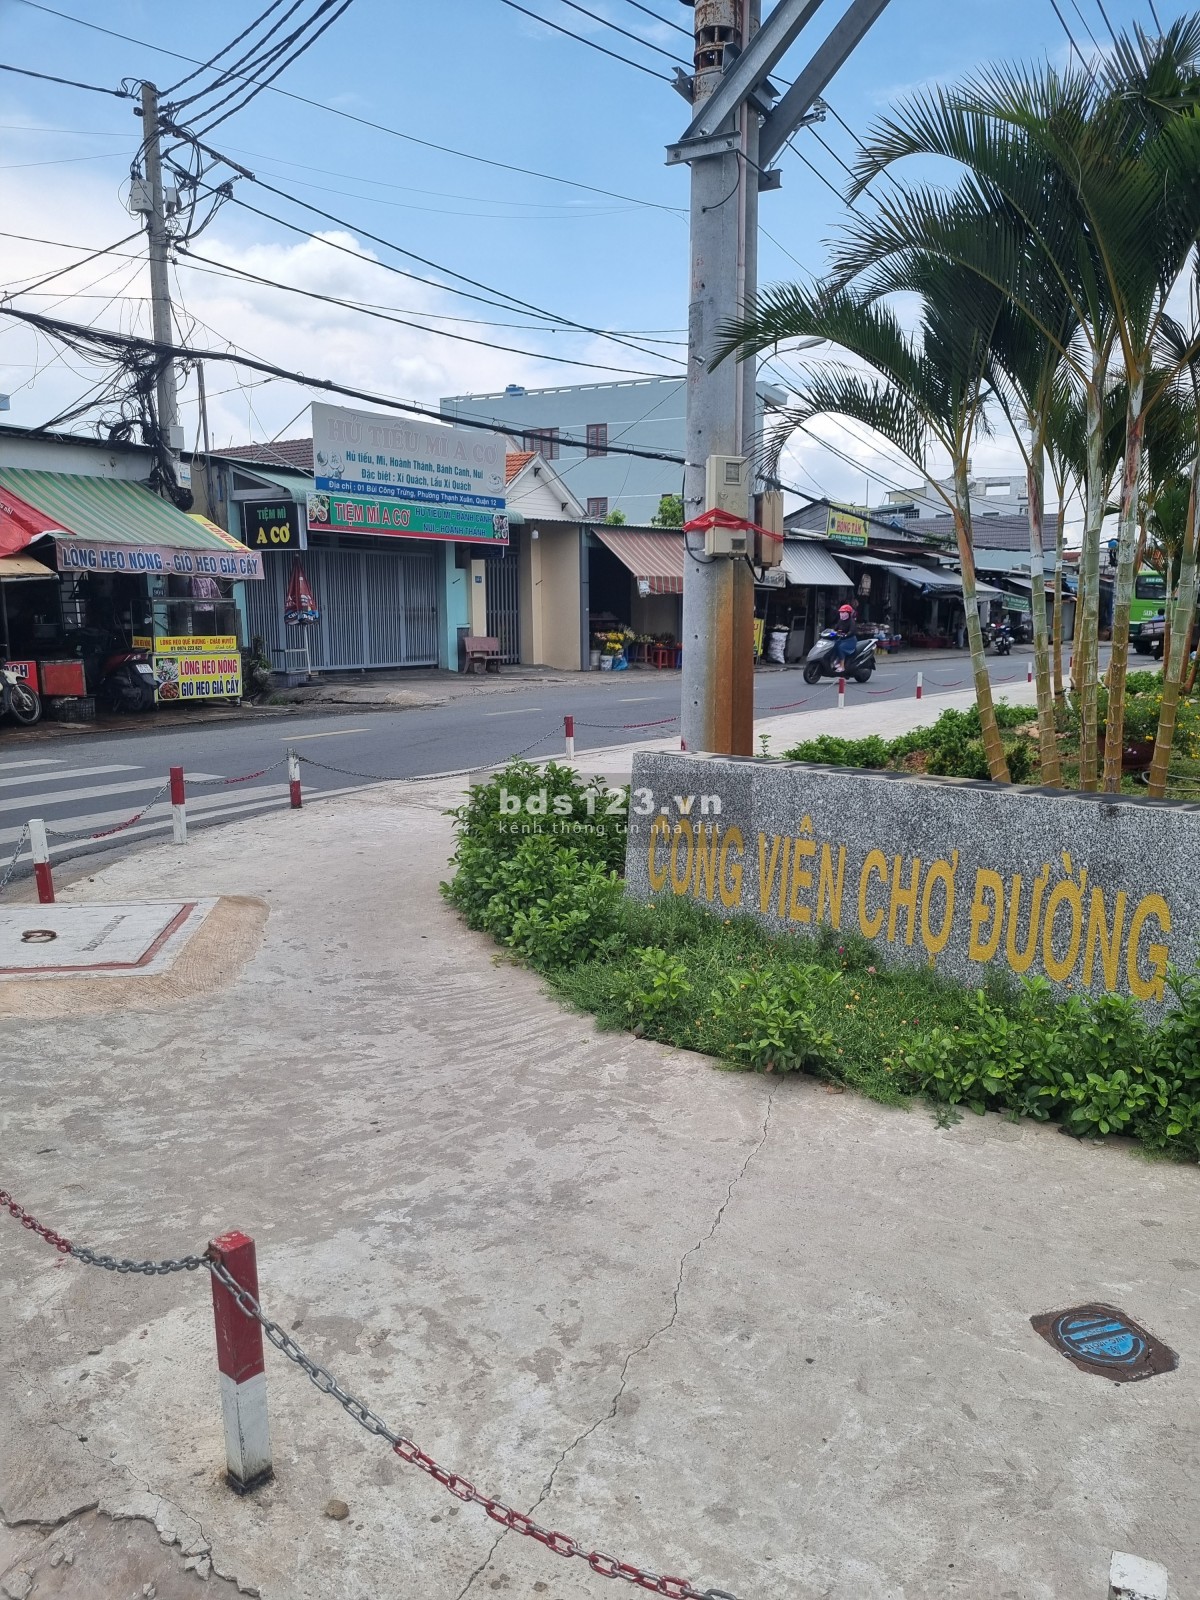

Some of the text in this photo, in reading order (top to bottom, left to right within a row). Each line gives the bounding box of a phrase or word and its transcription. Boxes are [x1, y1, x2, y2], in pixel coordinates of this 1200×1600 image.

[425, 432, 449, 458] MÌ
[454, 441, 468, 461] A
[472, 443, 498, 464] CƠ
[361, 468, 376, 481] Đặc
[377, 470, 391, 483] biệt
[452, 479, 472, 491] Quách
[436, 463, 453, 475] Bánh
[473, 469, 484, 480] Nui
[257, 506, 286, 521] TIỆM MÌ
[333, 500, 364, 526] TIỆM
[382, 507, 391, 525] A
[393, 508, 411, 527] CƠ
[256, 526, 268, 544] A
[270, 522, 290, 543] CƠ
[423, 523, 435, 532] NUI
[62, 543, 97, 568] LÒNG
[100, 549, 126, 569] HEO
[128, 548, 163, 570] NÓNG
[173, 552, 193, 572] GIÒ
[195, 555, 217, 573] HEO
[180, 657, 237, 676] LÒNG HEO NÓNG
[181, 678, 194, 697] GIÒ
[196, 680, 210, 696] HEO
[648, 797, 1172, 1002] CÔNG VIÊN CHỢ ĐƯỜNG
